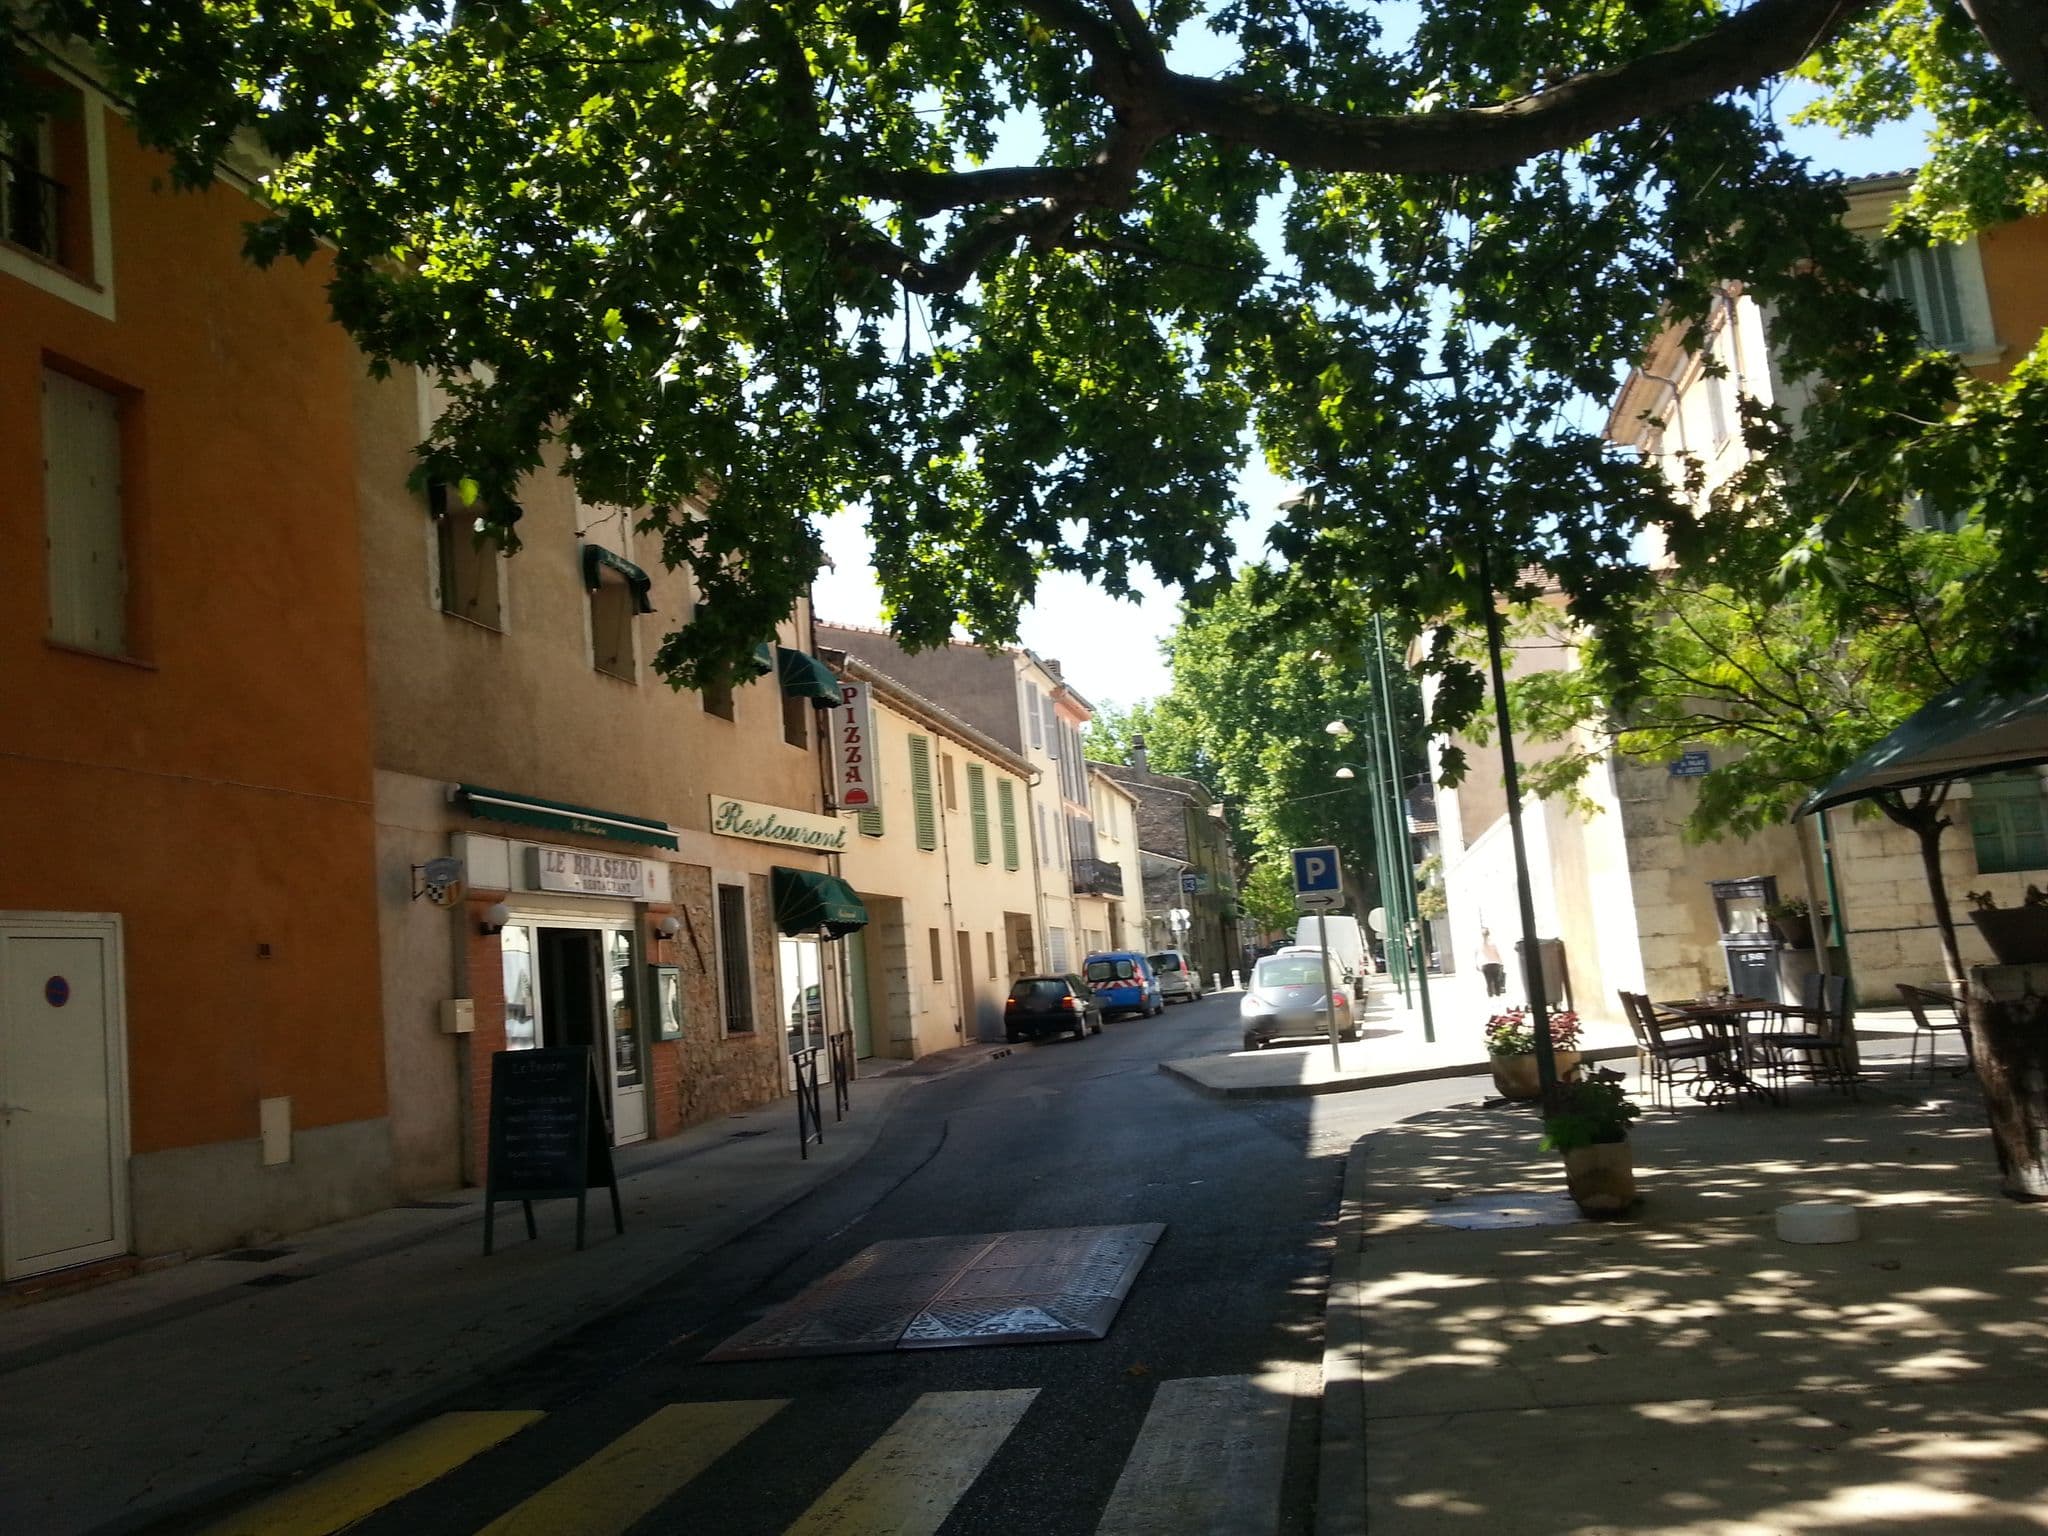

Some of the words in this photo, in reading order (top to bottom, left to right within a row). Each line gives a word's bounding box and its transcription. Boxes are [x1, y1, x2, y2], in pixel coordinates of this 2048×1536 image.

[842, 687, 862, 783] PIZZA
[715, 800, 847, 848] Restaurant
[546, 851, 566, 874] LE
[574, 855, 638, 881] BRASERO
[1305, 857, 1326, 885] P
